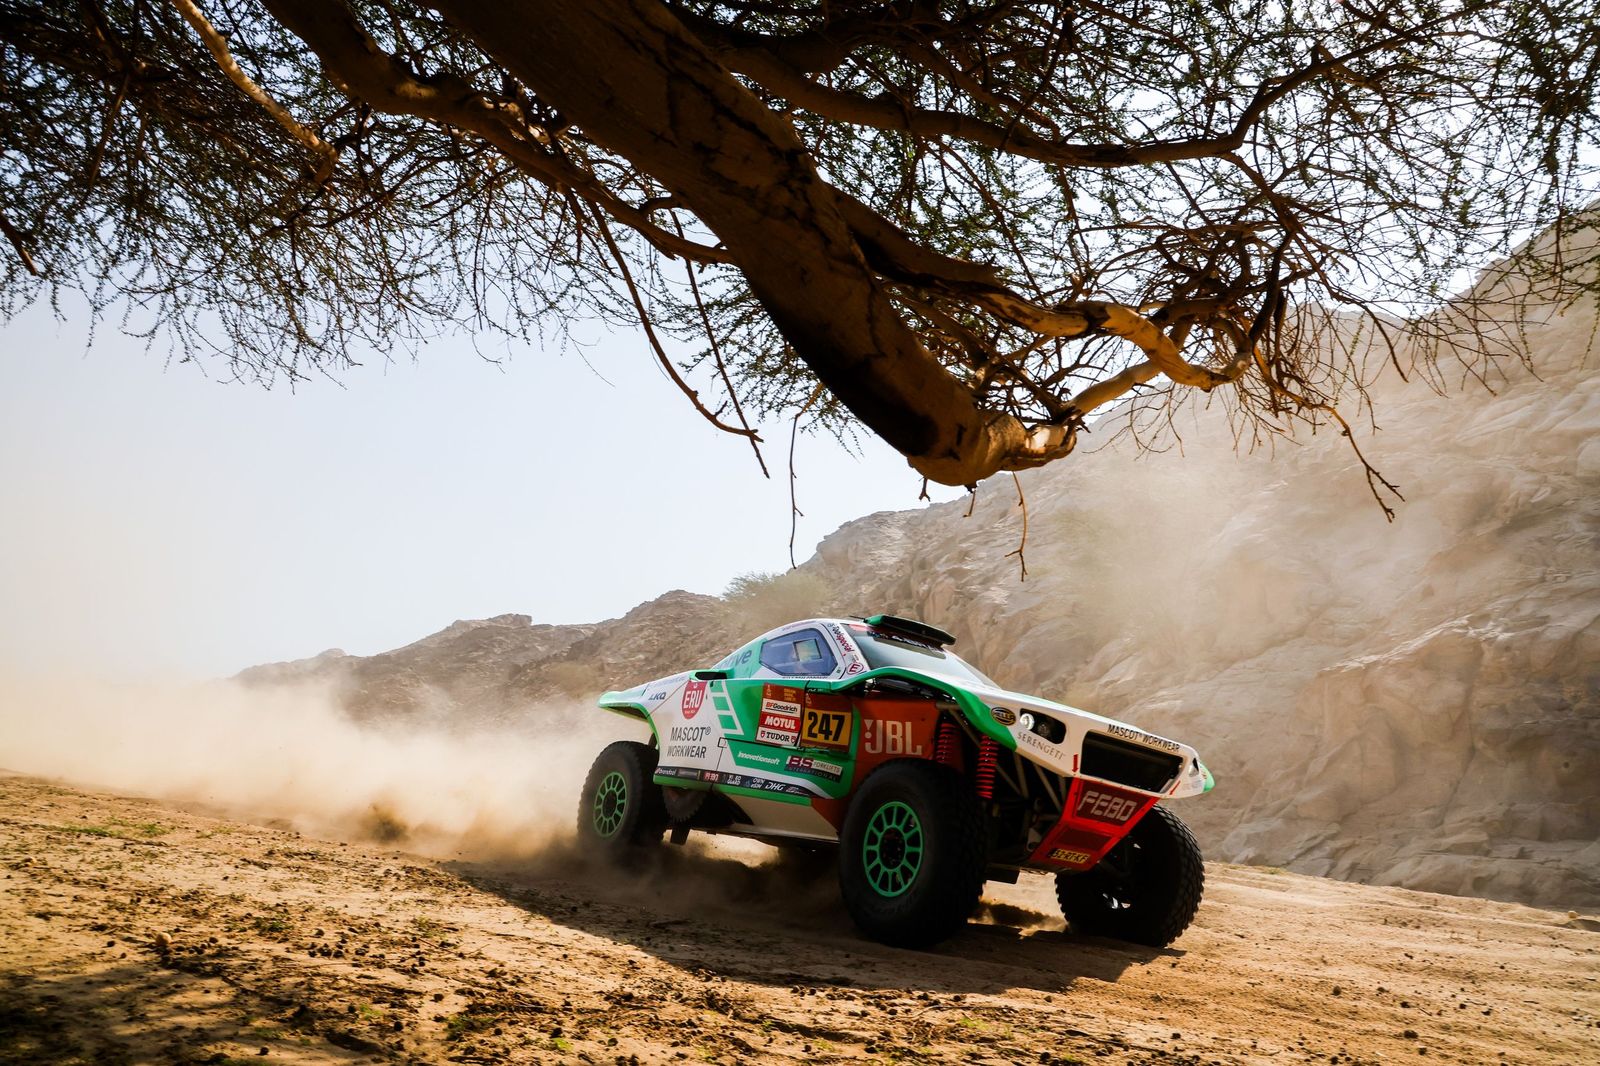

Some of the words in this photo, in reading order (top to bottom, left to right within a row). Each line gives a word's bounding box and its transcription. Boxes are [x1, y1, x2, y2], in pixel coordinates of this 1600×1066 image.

[683, 689, 703, 709] ERU
[766, 701, 798, 712] BFGoodrich
[764, 715, 796, 729] MOTUL
[807, 711, 845, 742] 247
[766, 731, 790, 743] TUDOR
[864, 719, 922, 756] JBL
[1142, 733, 1180, 752] WORKWEAR
[667, 745, 707, 759] WORKWEAR
[1077, 790, 1138, 821] FEBO
